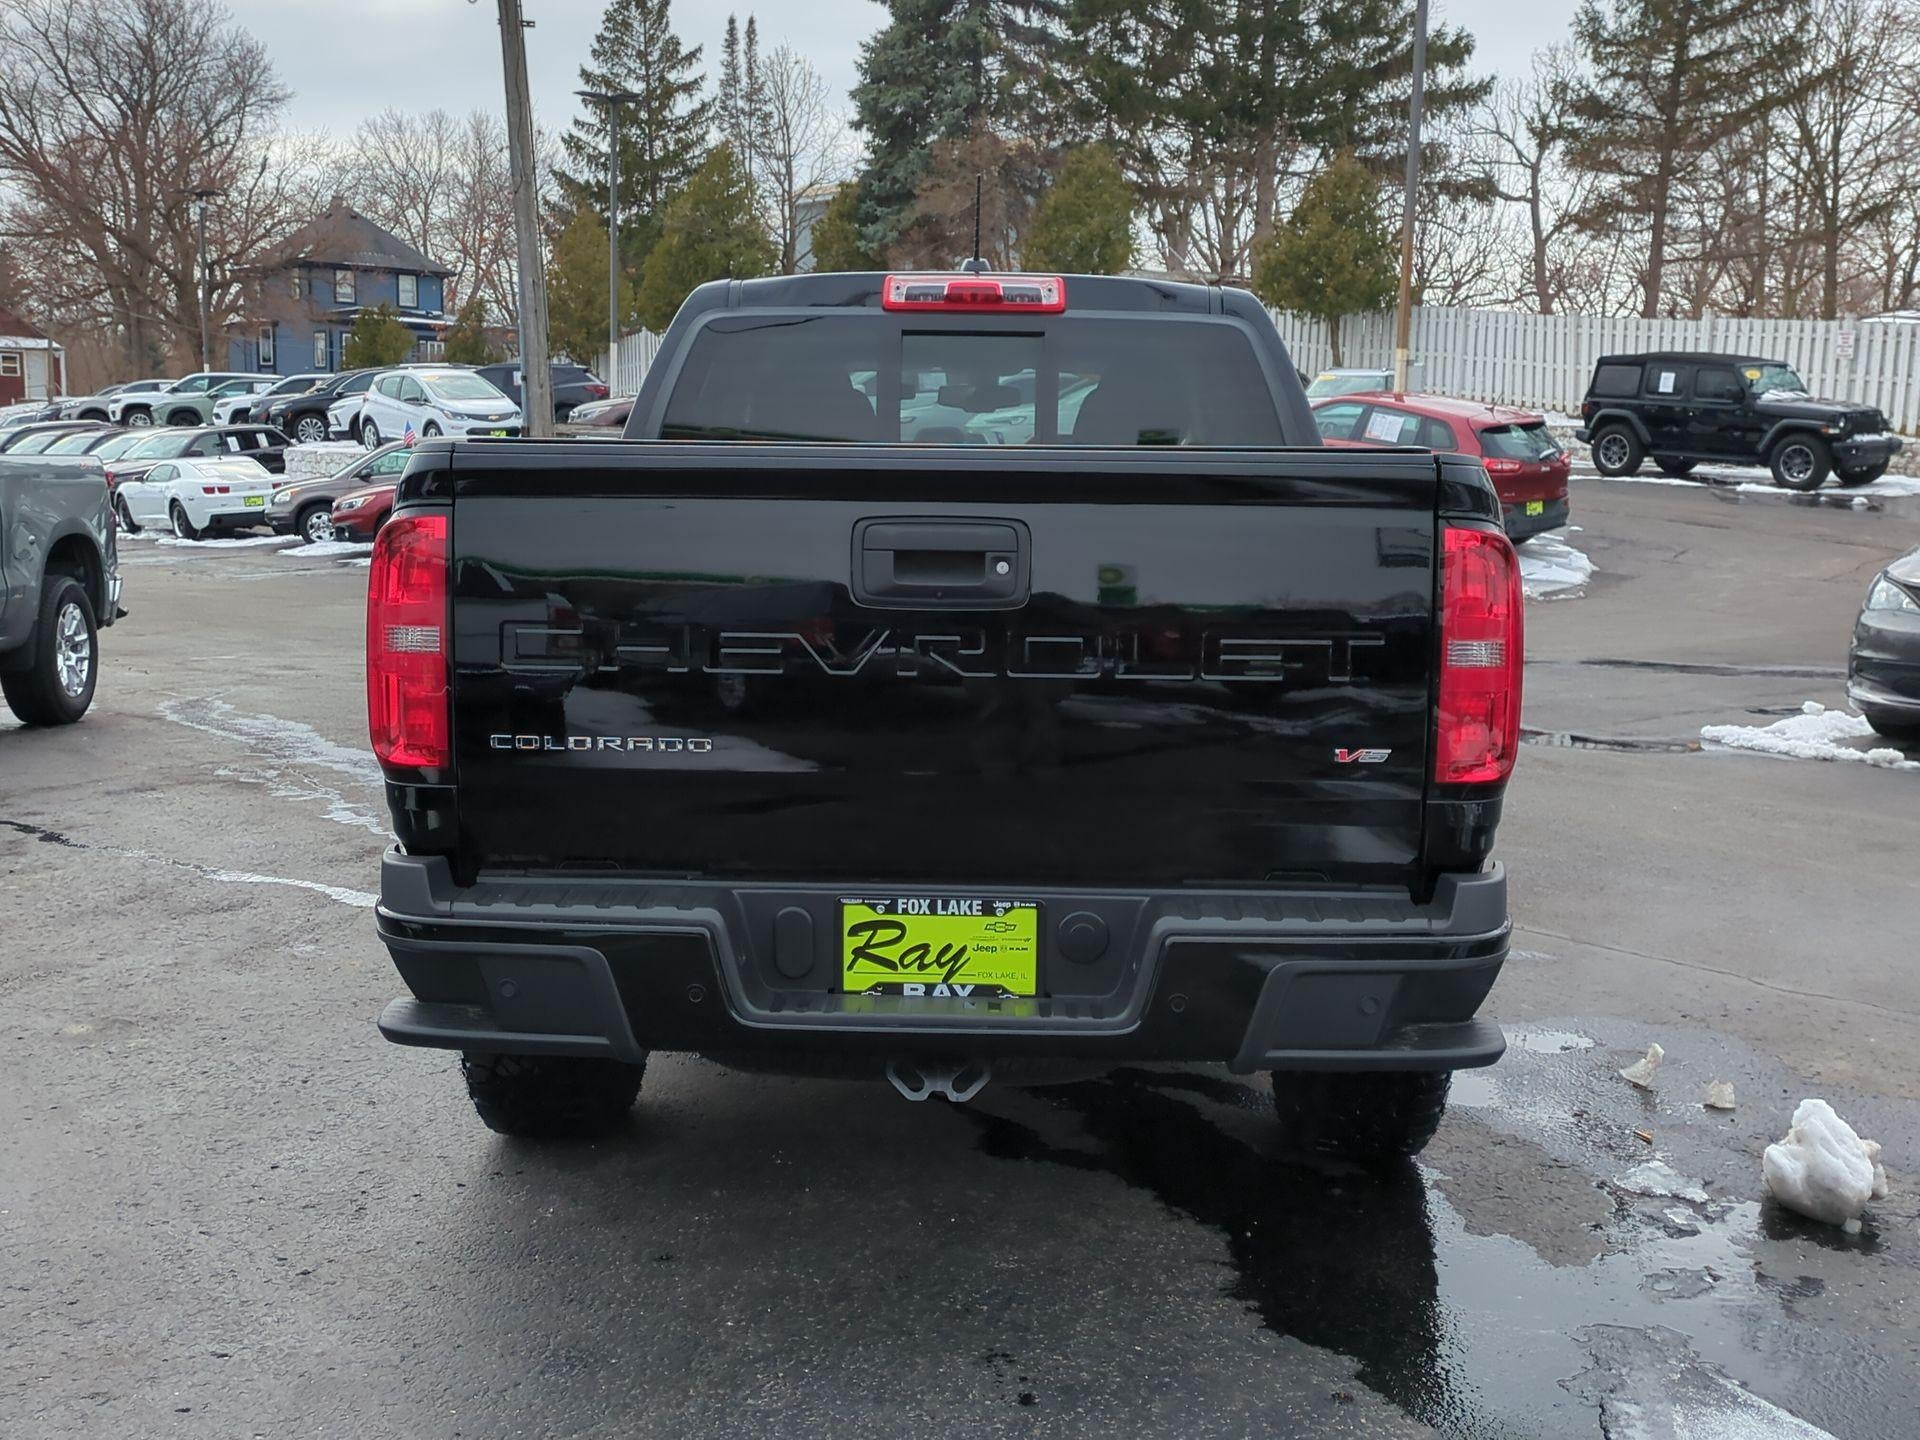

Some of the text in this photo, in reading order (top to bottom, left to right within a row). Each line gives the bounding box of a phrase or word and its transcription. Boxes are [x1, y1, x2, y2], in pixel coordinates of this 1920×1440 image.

[501, 620, 1386, 682] CHEVROLET
[489, 734, 713, 753] COLORADO
[1334, 748, 1392, 763] V6
[897, 898, 931, 915] FOX
[937, 899, 983, 916] LAKE
[846, 918, 971, 984] Ray
[972, 943, 998, 954] Jeep
[977, 971, 994, 979] FOX
[1020, 972, 1028, 980] IL
